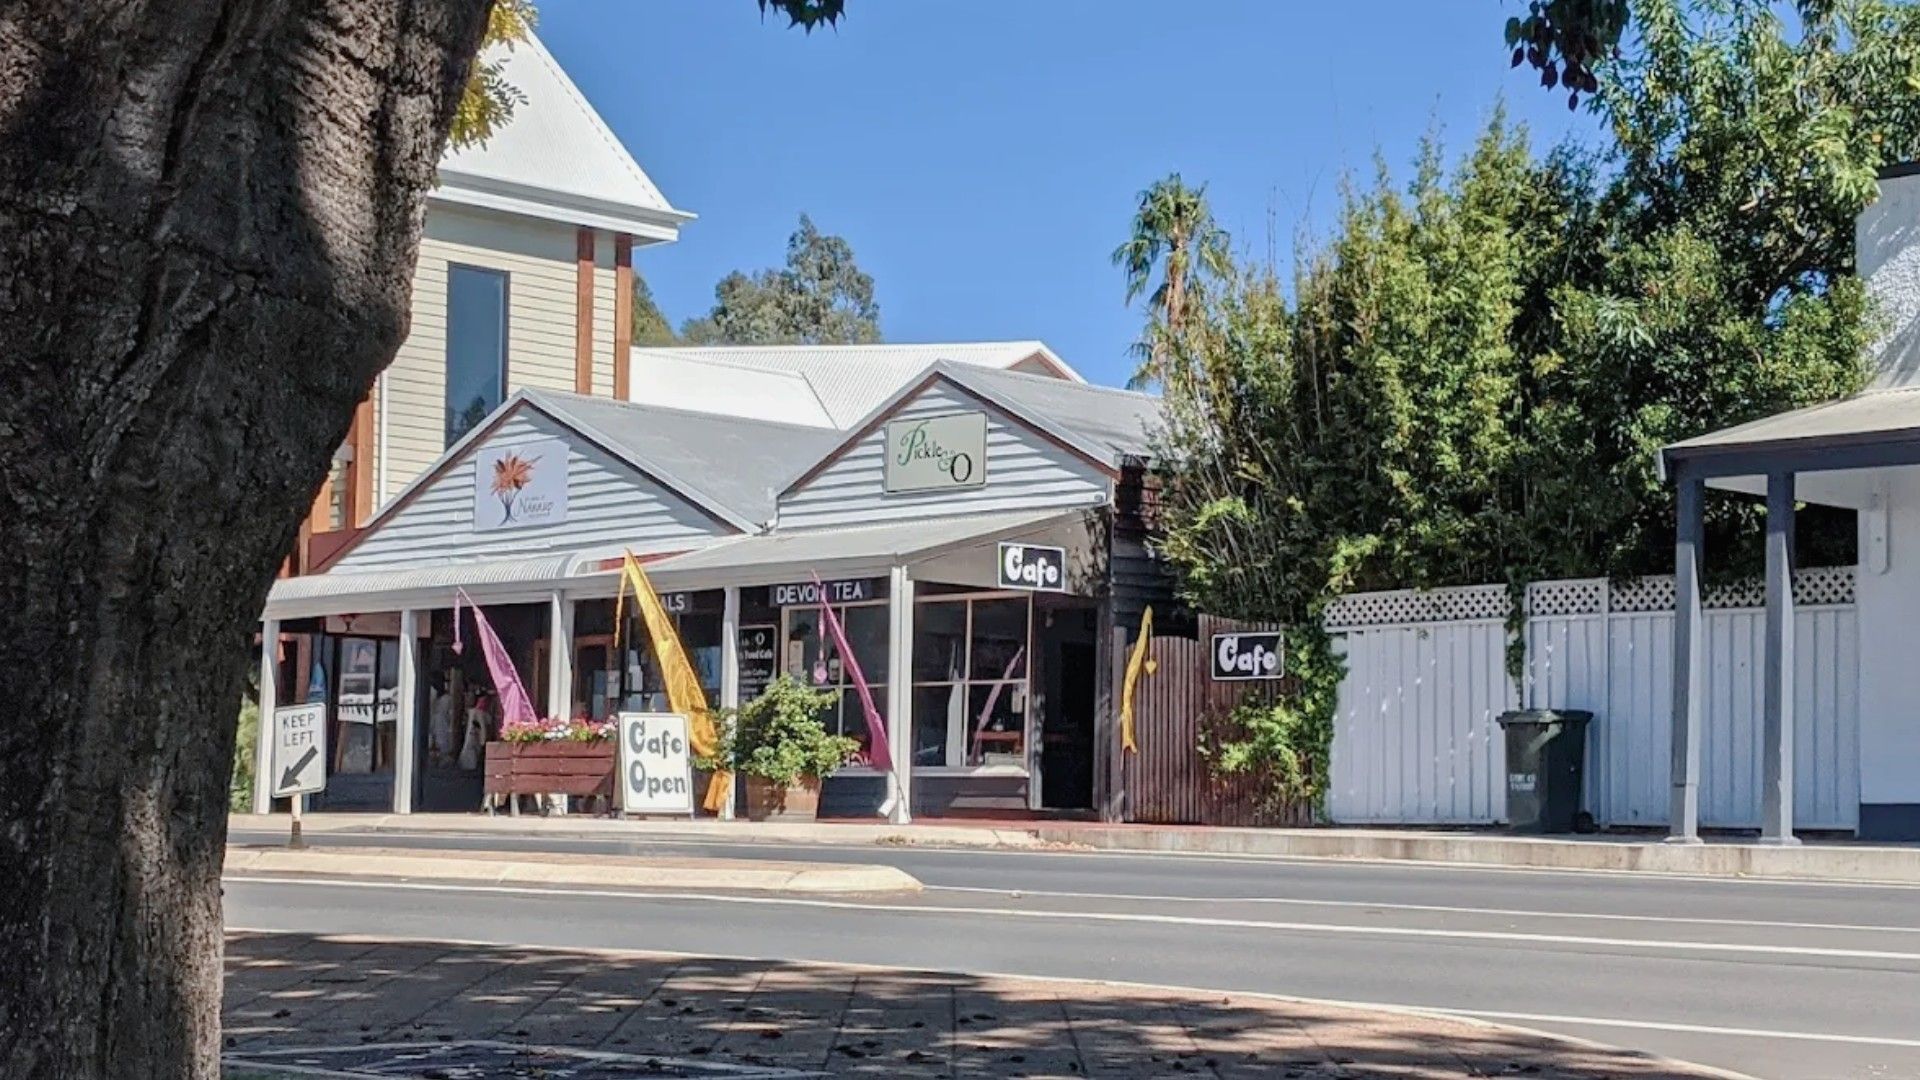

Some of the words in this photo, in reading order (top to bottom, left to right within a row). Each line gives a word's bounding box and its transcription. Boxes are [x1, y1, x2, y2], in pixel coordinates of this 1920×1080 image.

[898, 420, 942, 466] Pickle
[950, 452, 972, 483] O
[1005, 547, 1058, 588] Cafe
[776, 583, 827, 604] DEVON
[833, 581, 863, 600] TEA
[1218, 636, 1276, 676] Cafe
[283, 712, 315, 729] KEEP
[283, 730, 313, 747] LEFT
[629, 720, 682, 759] Cafe
[629, 760, 686, 798] Open
